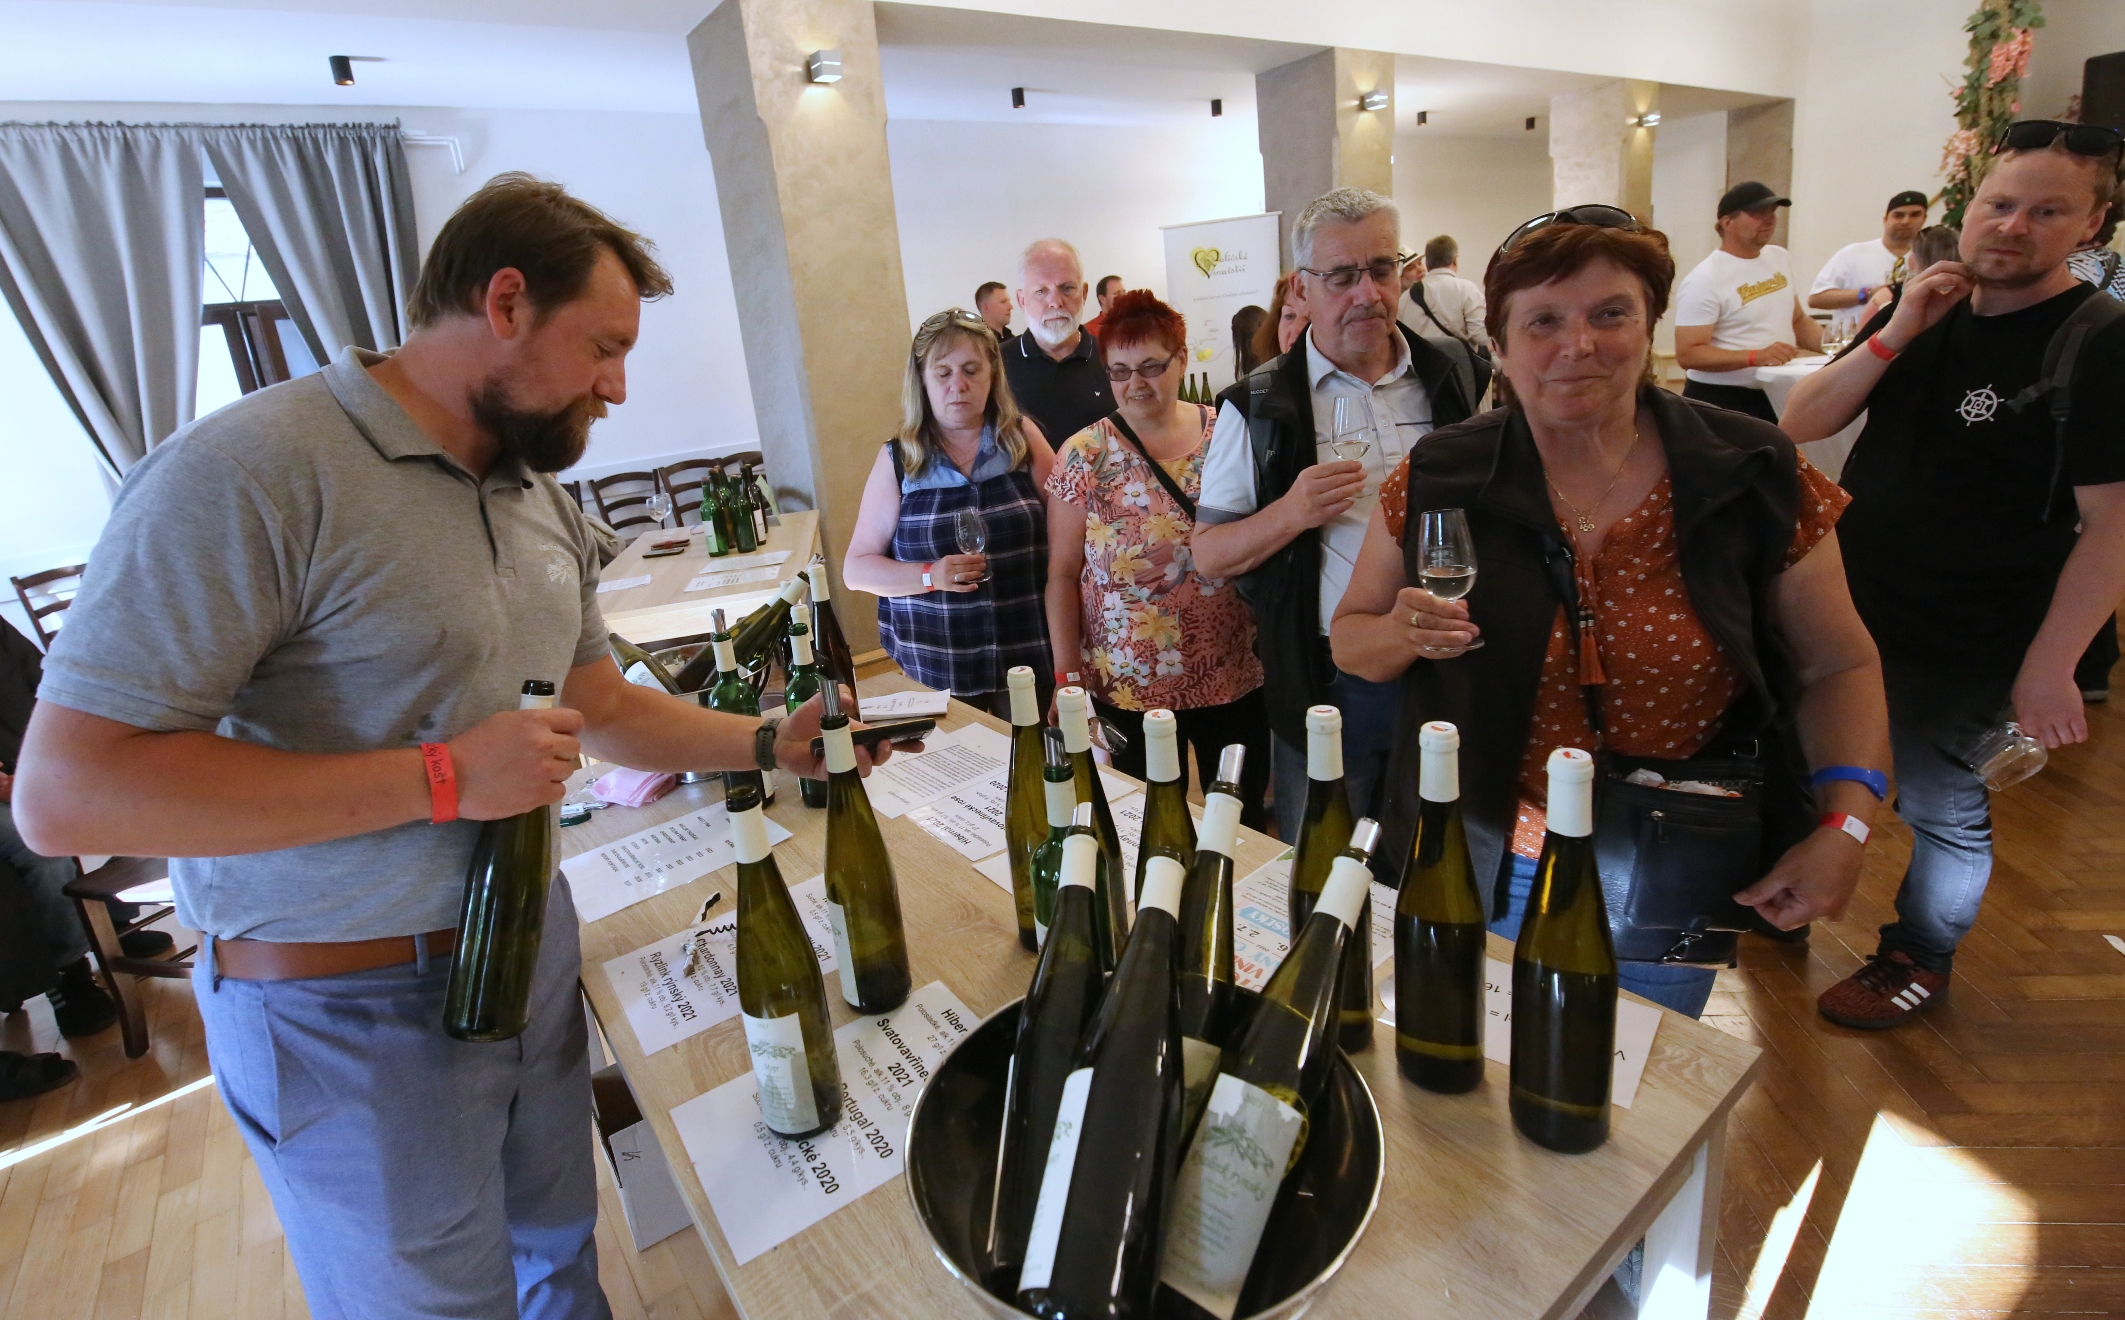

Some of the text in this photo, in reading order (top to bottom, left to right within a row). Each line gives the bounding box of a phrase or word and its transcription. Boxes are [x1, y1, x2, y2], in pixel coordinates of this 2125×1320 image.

[696, 938, 738, 997] Chardonnay 2021
[649, 951, 698, 1022] Ryzlink rýnský 2021
[941, 1008, 969, 1036] Hiber
[887, 1062, 914, 1088] 2021
[877, 1093, 893, 1112] cukru
[753, 1121, 766, 1133] 0,5
[768, 1149, 783, 1169] cukru
[865, 1128, 894, 1159] 2020
[811, 1162, 840, 1195] 2020
